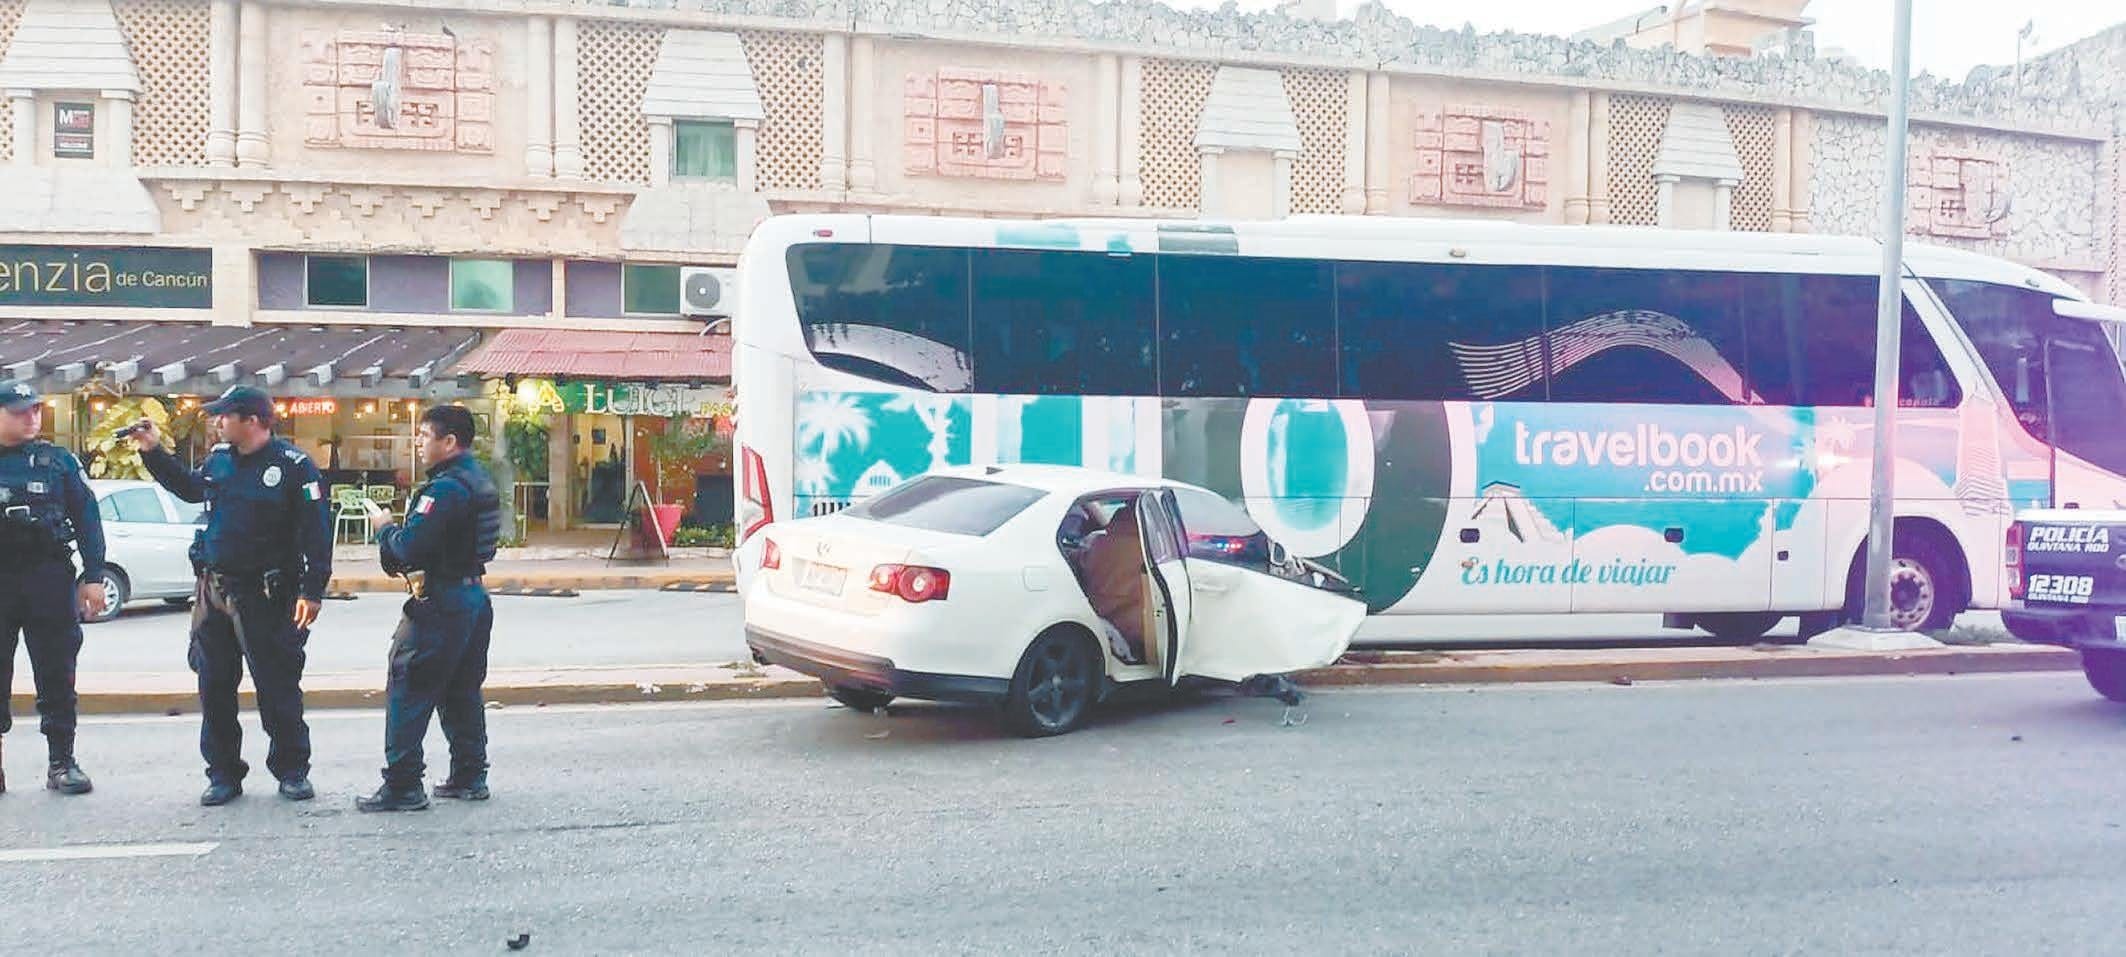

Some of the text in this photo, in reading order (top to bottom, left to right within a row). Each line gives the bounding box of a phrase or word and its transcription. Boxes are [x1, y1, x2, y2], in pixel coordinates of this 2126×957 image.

[116, 272, 138, 287] de
[142, 271, 208, 288] Cancún
[289, 400, 336, 416] ABIERTO
[1515, 421, 1762, 467] travelbook
[1644, 470, 1763, 493] .com.mx
[2029, 523, 2109, 543] POLICÍA
[1461, 556, 1676, 587] Es hora de viajar
[2028, 574, 2094, 596] 12308
